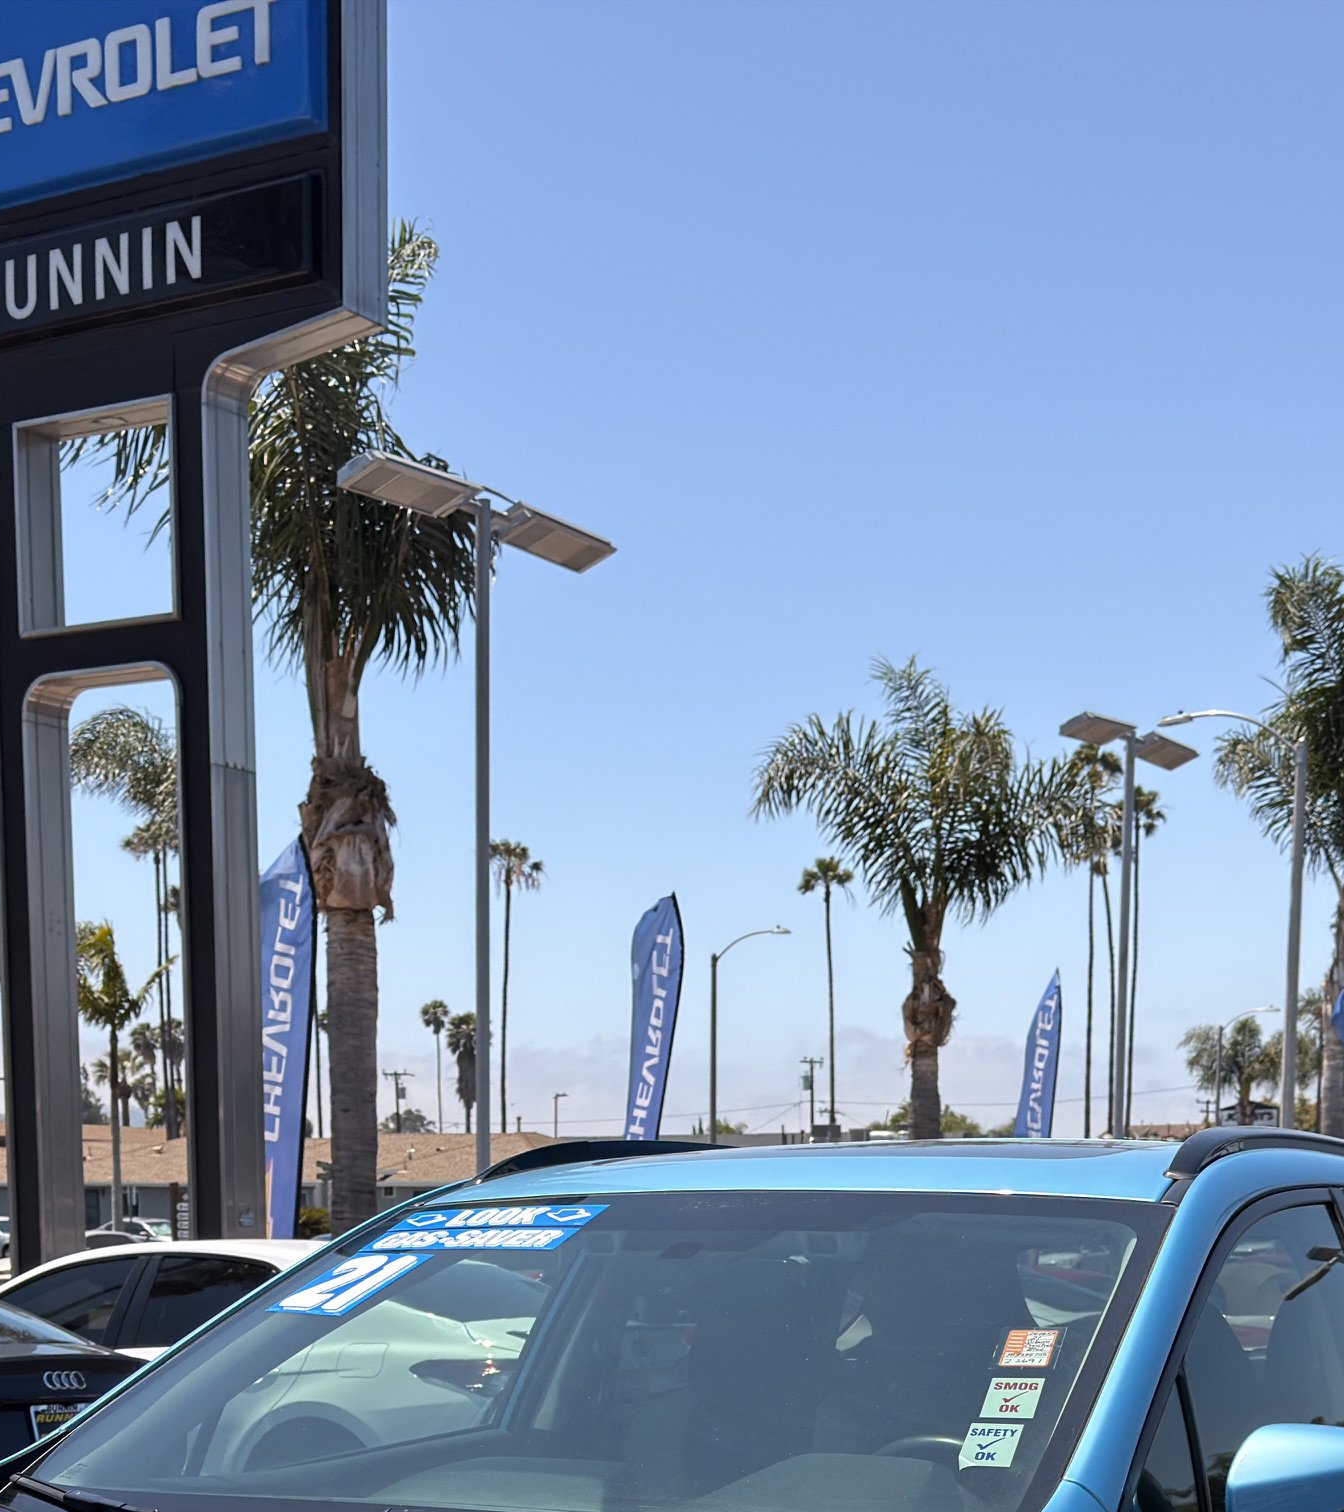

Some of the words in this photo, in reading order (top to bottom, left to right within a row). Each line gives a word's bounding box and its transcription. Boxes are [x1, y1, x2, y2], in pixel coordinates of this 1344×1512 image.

[444, 1206, 548, 1227] LOOK
[279, 1254, 419, 1313] 21
[993, 1382, 1039, 1391] SMOG
[998, 1404, 1021, 1413] OK
[970, 1428, 1018, 1437] SAFETY
[974, 1452, 997, 1461] OK
